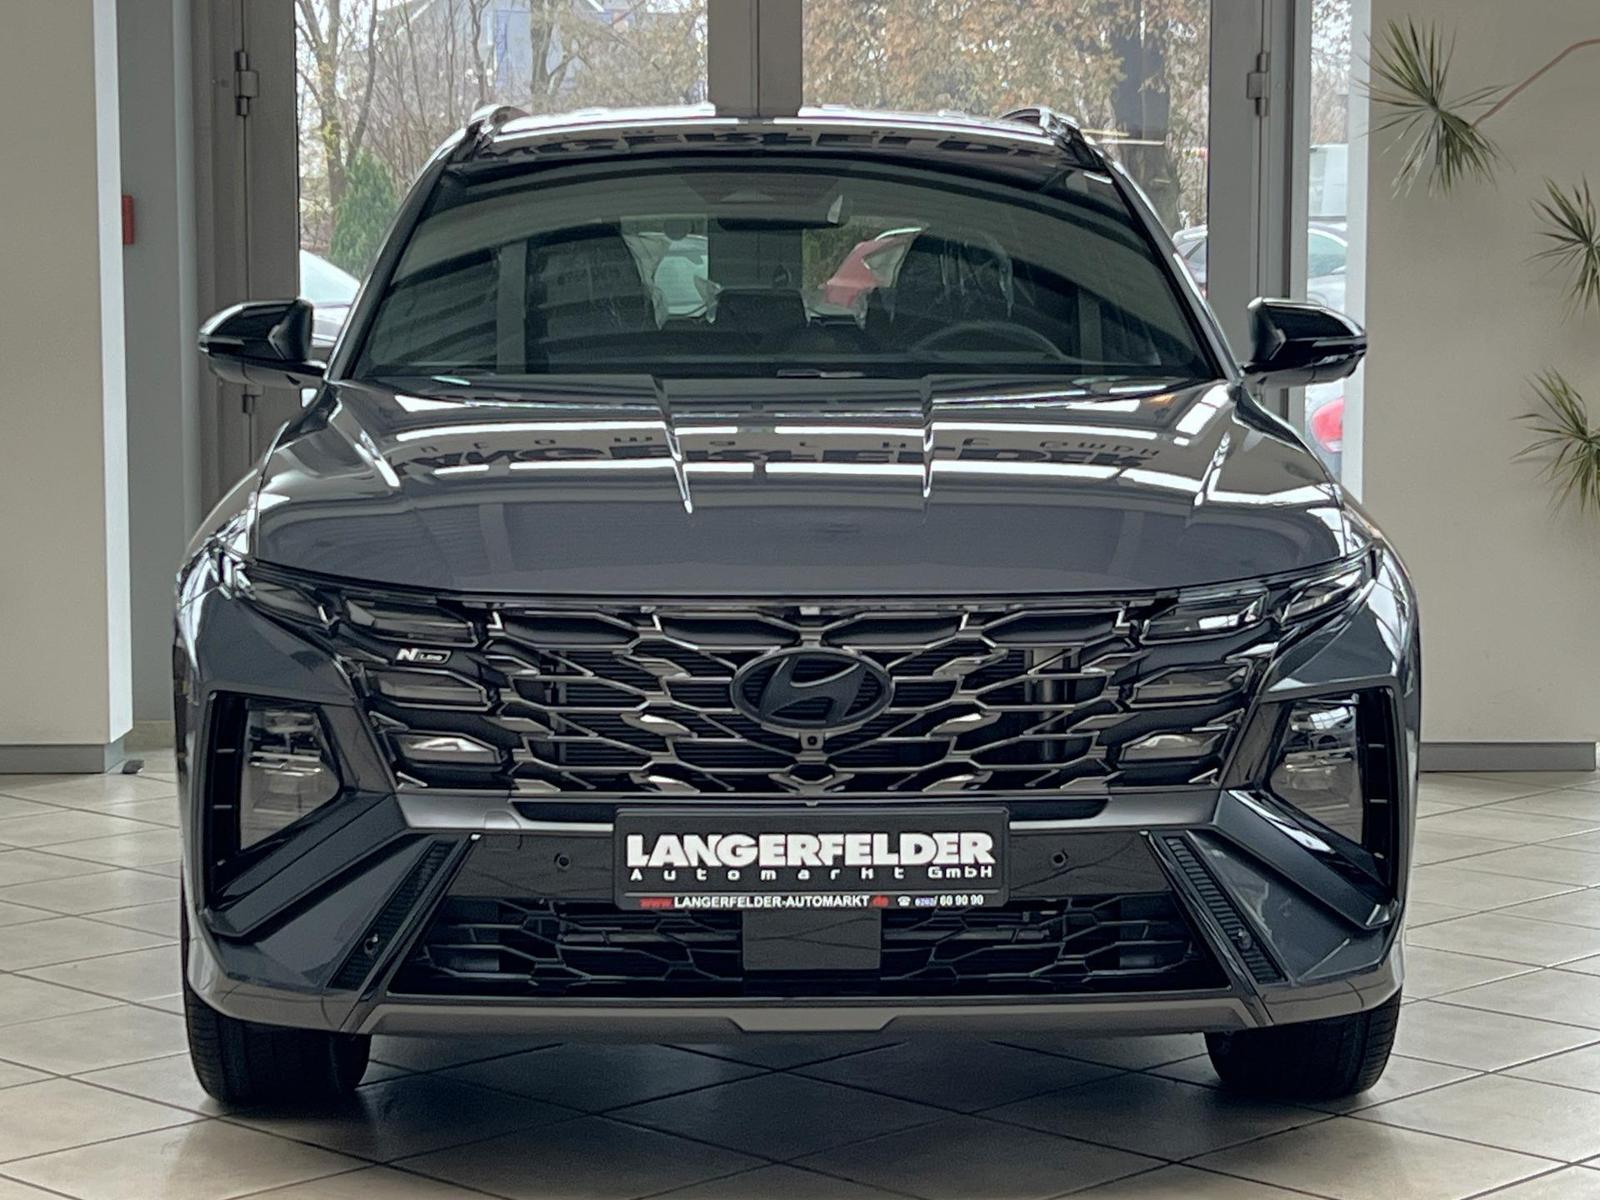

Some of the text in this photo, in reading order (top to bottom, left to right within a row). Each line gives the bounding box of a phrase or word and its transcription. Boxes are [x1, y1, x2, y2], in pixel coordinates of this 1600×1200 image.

[396, 647, 419, 661] N
[626, 833, 996, 867] LANGERFELDER
[630, 865, 993, 881] Automarkt GmbH
